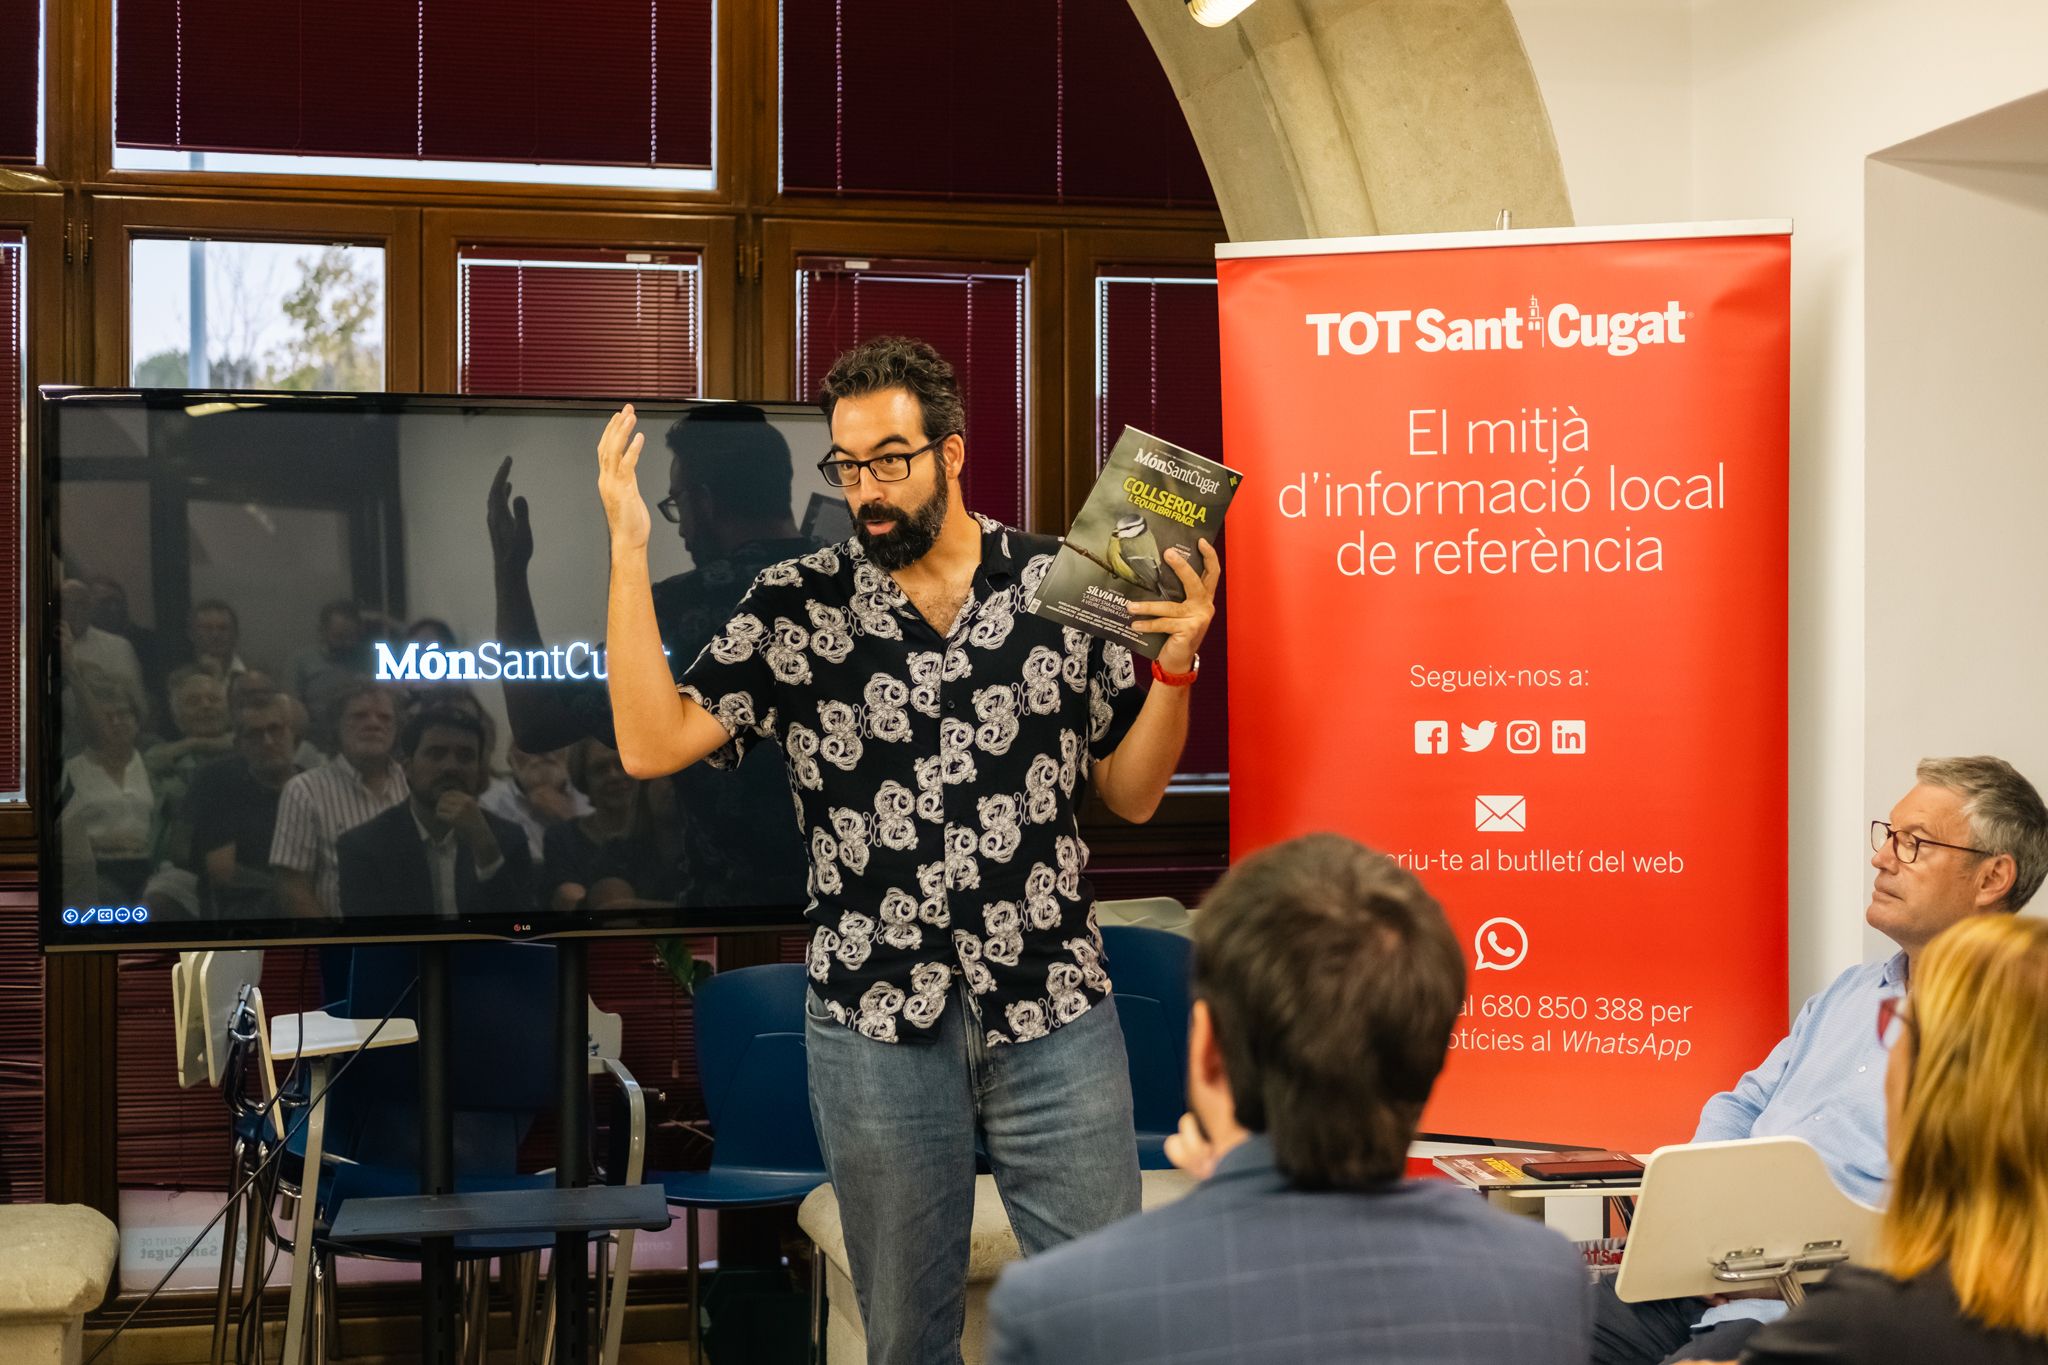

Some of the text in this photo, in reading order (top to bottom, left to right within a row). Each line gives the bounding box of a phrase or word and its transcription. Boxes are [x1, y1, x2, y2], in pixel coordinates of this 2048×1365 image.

[1306, 300, 1686, 357] TOT Sant Cugat
[1409, 406, 1589, 464] El mitjà
[1133, 447, 1220, 494] MónSantCugat
[1278, 463, 1724, 519] d'informació local
[1336, 526, 1663, 576] de referència
[1113, 594, 1131, 607] MU
[375, 642, 670, 681] MónSantCu
[1410, 664, 1589, 693] Segueix-nos a:
[1470, 848, 1490, 871] al
[1498, 848, 1584, 872] butlletí
[1589, 849, 1625, 873] del
[1632, 850, 1684, 874] web
[1481, 994, 1531, 1018] 680
[1538, 995, 1588, 1020] 850
[1595, 997, 1644, 1022] 388
[1651, 1004, 1693, 1027] per
[1447, 1027, 1692, 1061] otícies al WhatsApp
